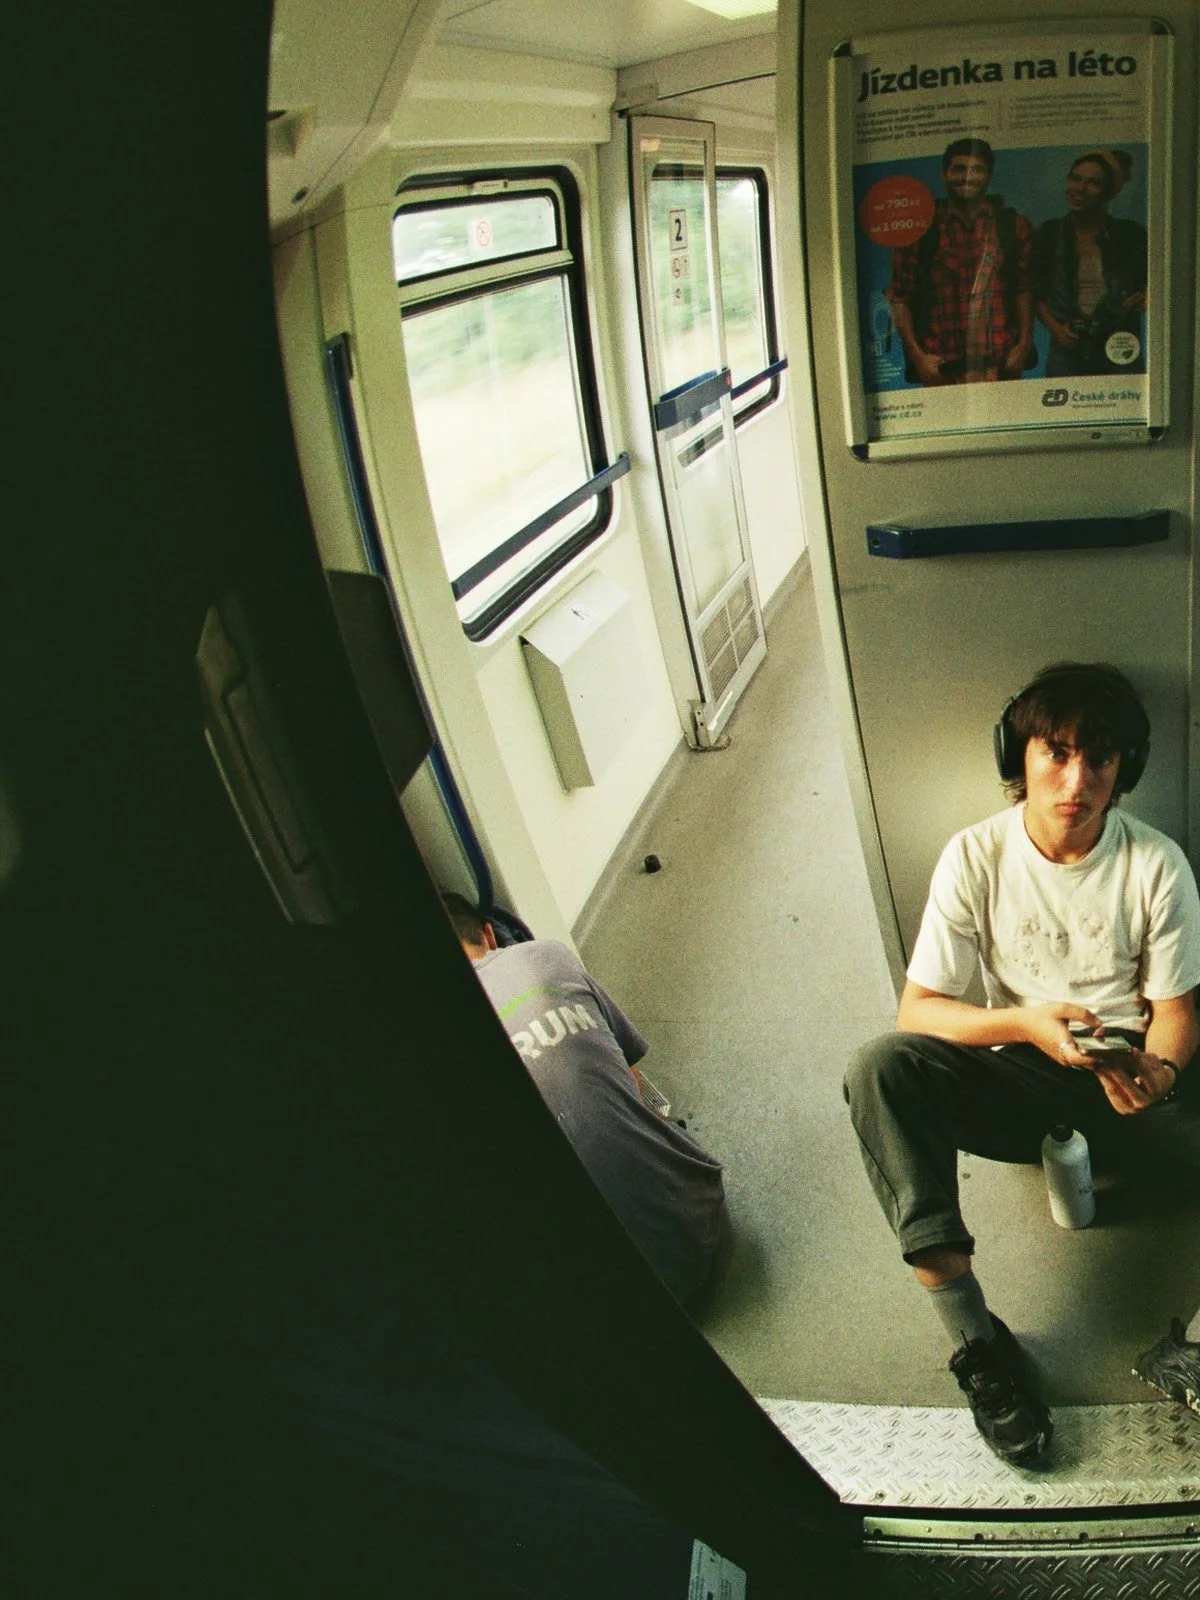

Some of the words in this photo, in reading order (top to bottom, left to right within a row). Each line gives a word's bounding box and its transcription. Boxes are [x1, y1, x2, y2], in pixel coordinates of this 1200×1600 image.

[858, 58, 1003, 102] Jízdenka
[1013, 57, 1057, 80] na
[1068, 49, 1138, 77] léto
[674, 218, 683, 242] 2
